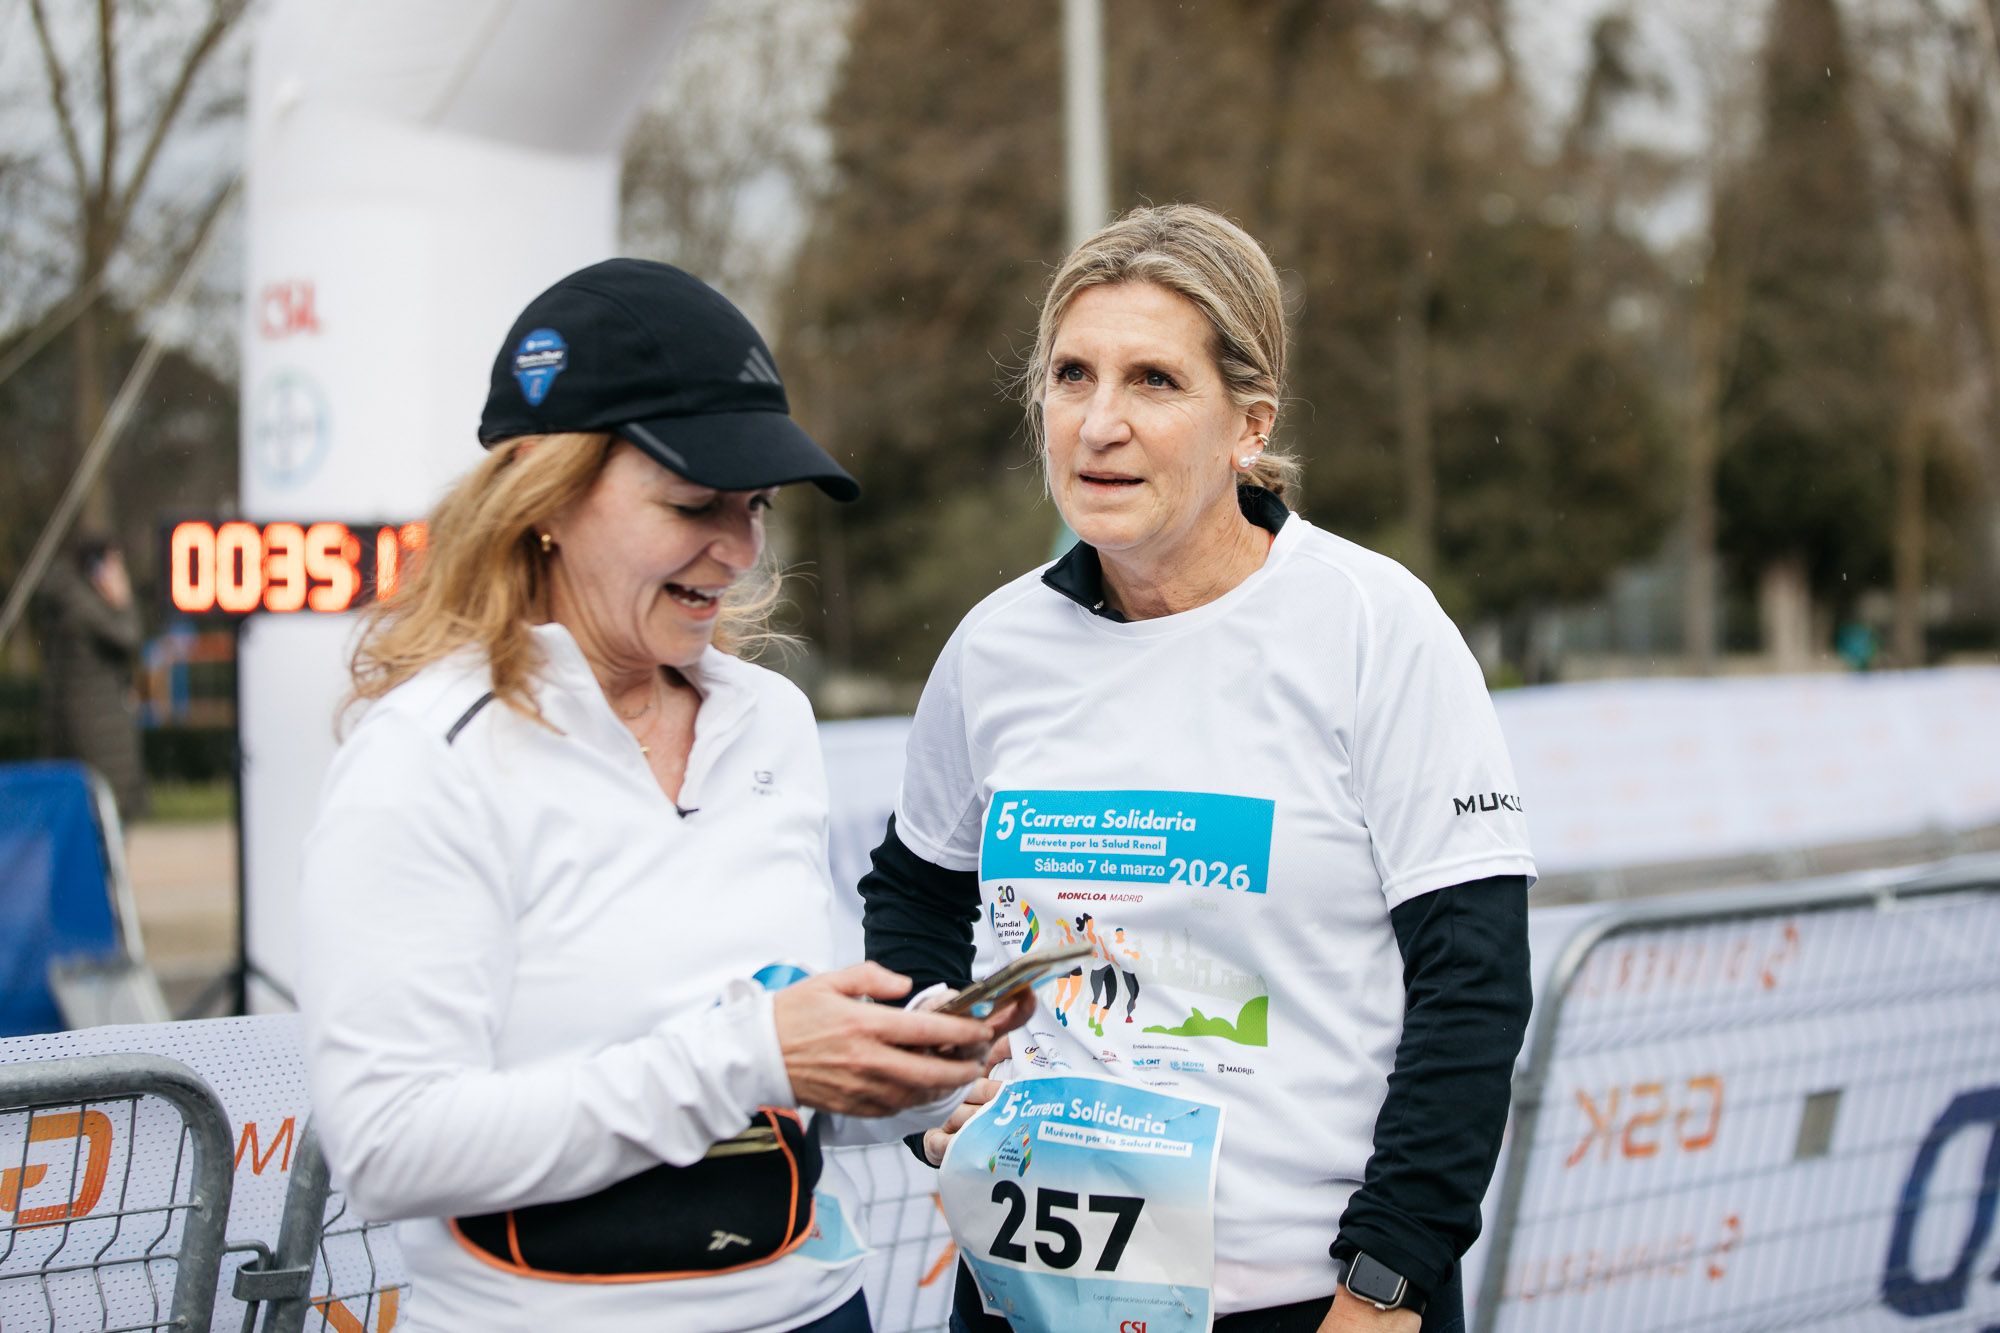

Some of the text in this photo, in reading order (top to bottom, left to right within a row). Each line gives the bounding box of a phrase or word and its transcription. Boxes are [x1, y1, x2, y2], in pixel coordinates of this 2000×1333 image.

[1020, 808, 1096, 829] Carrera
[1101, 809, 1197, 832] Solidaria
[1026, 837, 1161, 851] Muévete por la Salud Renal
[1034, 858, 1250, 892] Sábado 7 de marzo 2026
[1057, 892, 1144, 903] MONCLOA MADRID
[1020, 1099, 1064, 1118] Carrera
[1069, 1097, 1167, 1135] Solidaria
[1044, 1125, 1084, 1140] Muévete
[1085, 1133, 1101, 1144] por
[1119, 1138, 1152, 1149] Salud
[989, 1180, 1145, 1271] 257
